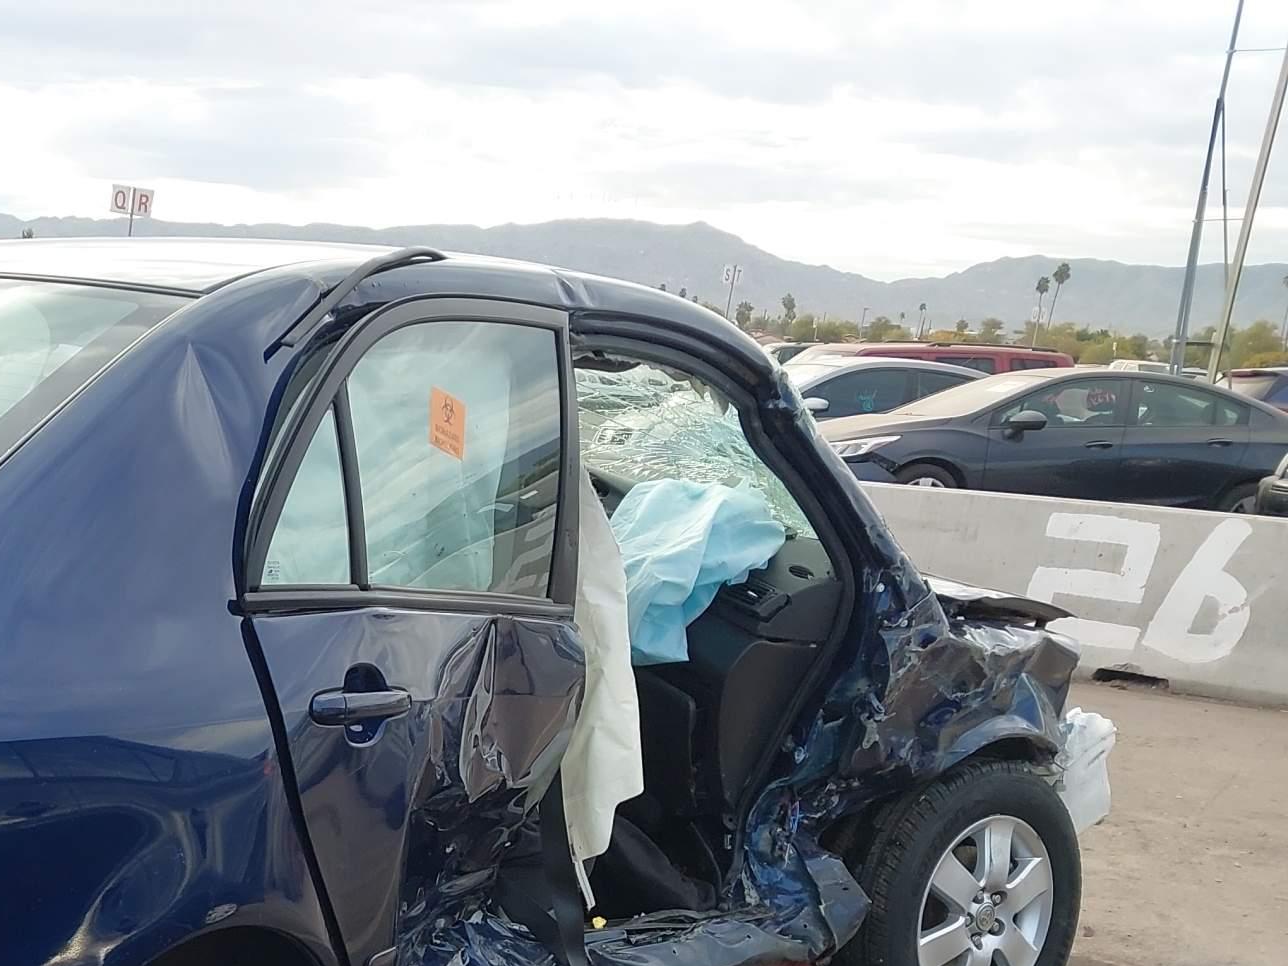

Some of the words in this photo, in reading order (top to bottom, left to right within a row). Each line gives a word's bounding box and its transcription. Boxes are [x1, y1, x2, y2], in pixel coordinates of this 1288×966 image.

[114, 190, 126, 210] Q
[138, 193, 150, 213] R
[1026, 512, 1253, 664] 26
